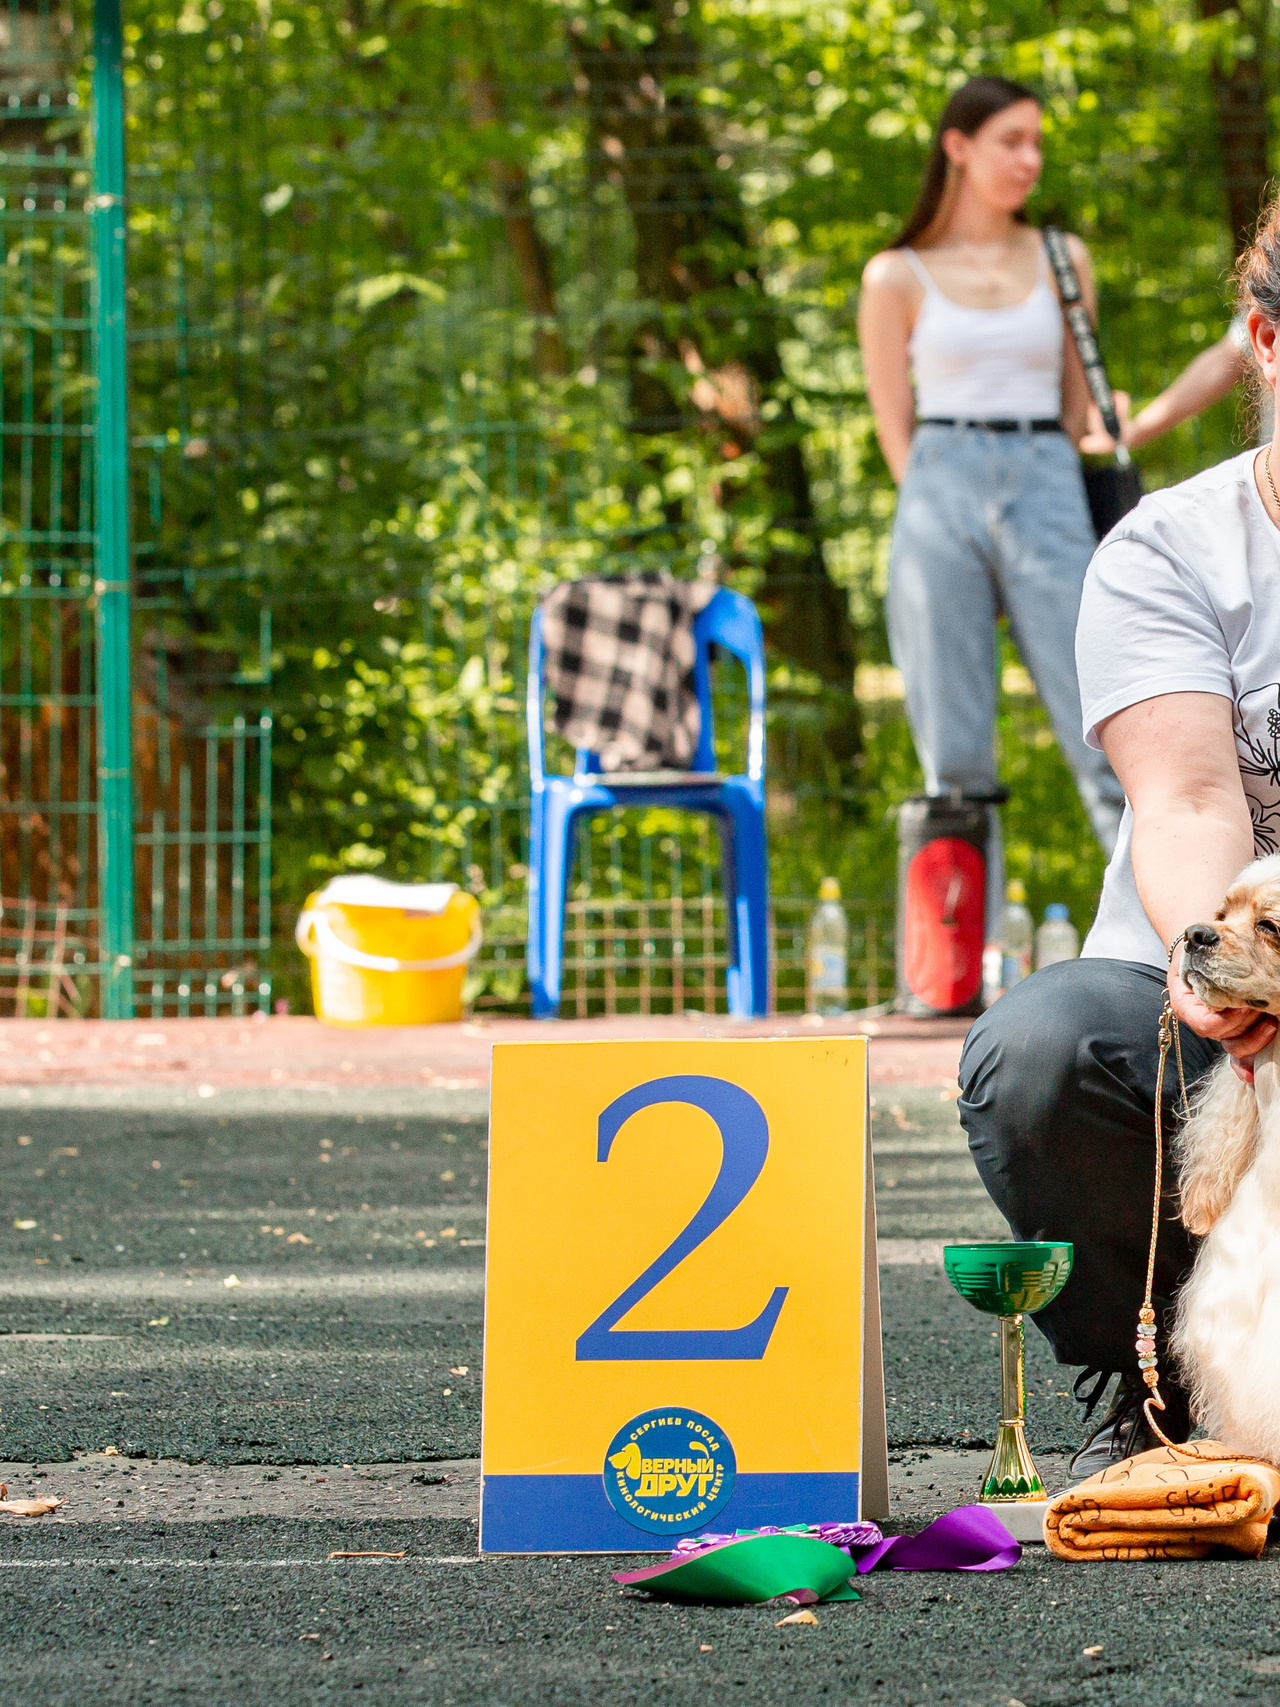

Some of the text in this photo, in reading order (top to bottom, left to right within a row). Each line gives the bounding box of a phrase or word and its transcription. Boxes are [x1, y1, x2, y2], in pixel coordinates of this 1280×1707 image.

[575, 1073, 790, 1362] 2
[630, 1417, 721, 1452] СЕРГИЕВ ПОСАД
[616, 1463, 725, 1522] КИНОЛОГИЧЕСКИЙ ЦЕНТР
[634, 1473, 714, 1497] ДРУГ
